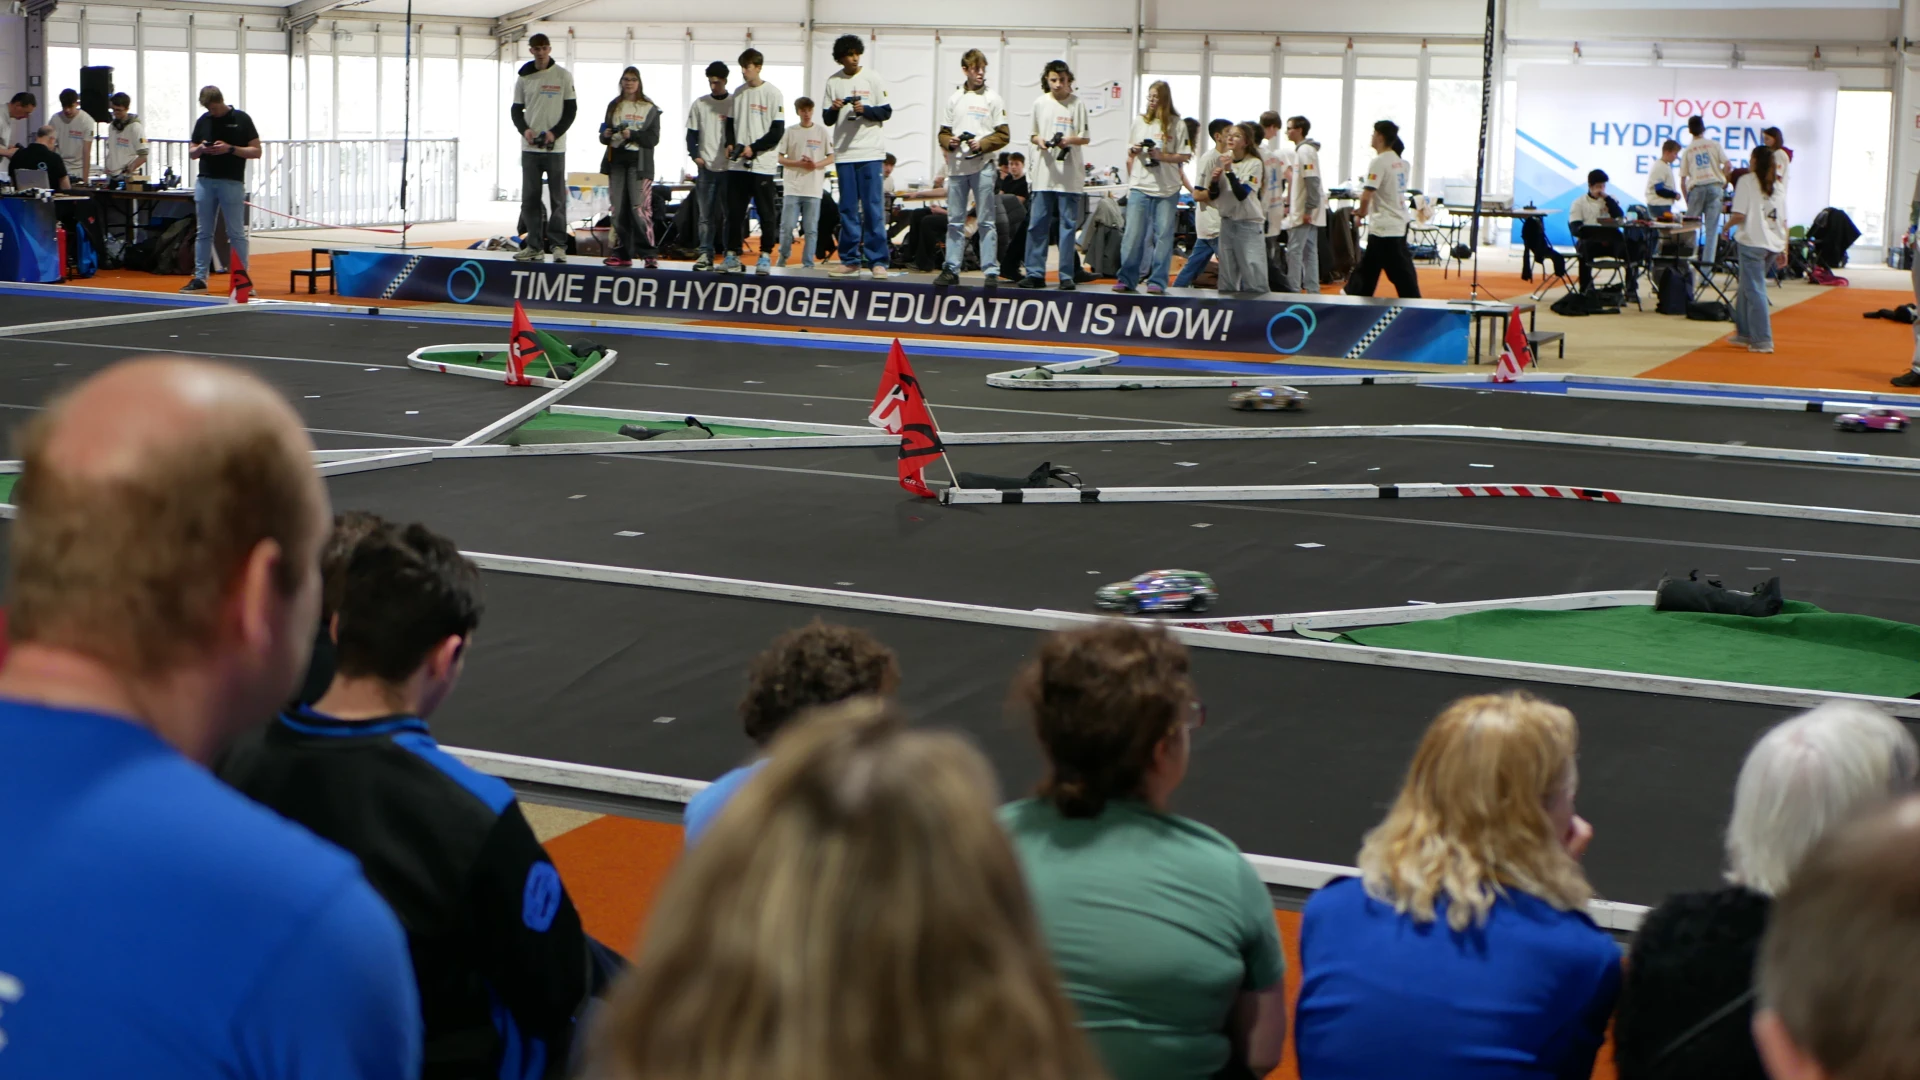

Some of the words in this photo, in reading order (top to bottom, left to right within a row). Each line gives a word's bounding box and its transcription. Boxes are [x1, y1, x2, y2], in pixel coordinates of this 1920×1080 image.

[1659, 99, 1765, 120] TOYOTA
[1695, 153, 1710, 167] 85
[511, 270, 586, 303] TIME
[593, 275, 658, 308] FOR
[666, 279, 860, 320] HYDROGEN
[866, 290, 1073, 332] EDUCATION
[1080, 303, 1117, 335] IS
[1125, 305, 1234, 342] NOW!
